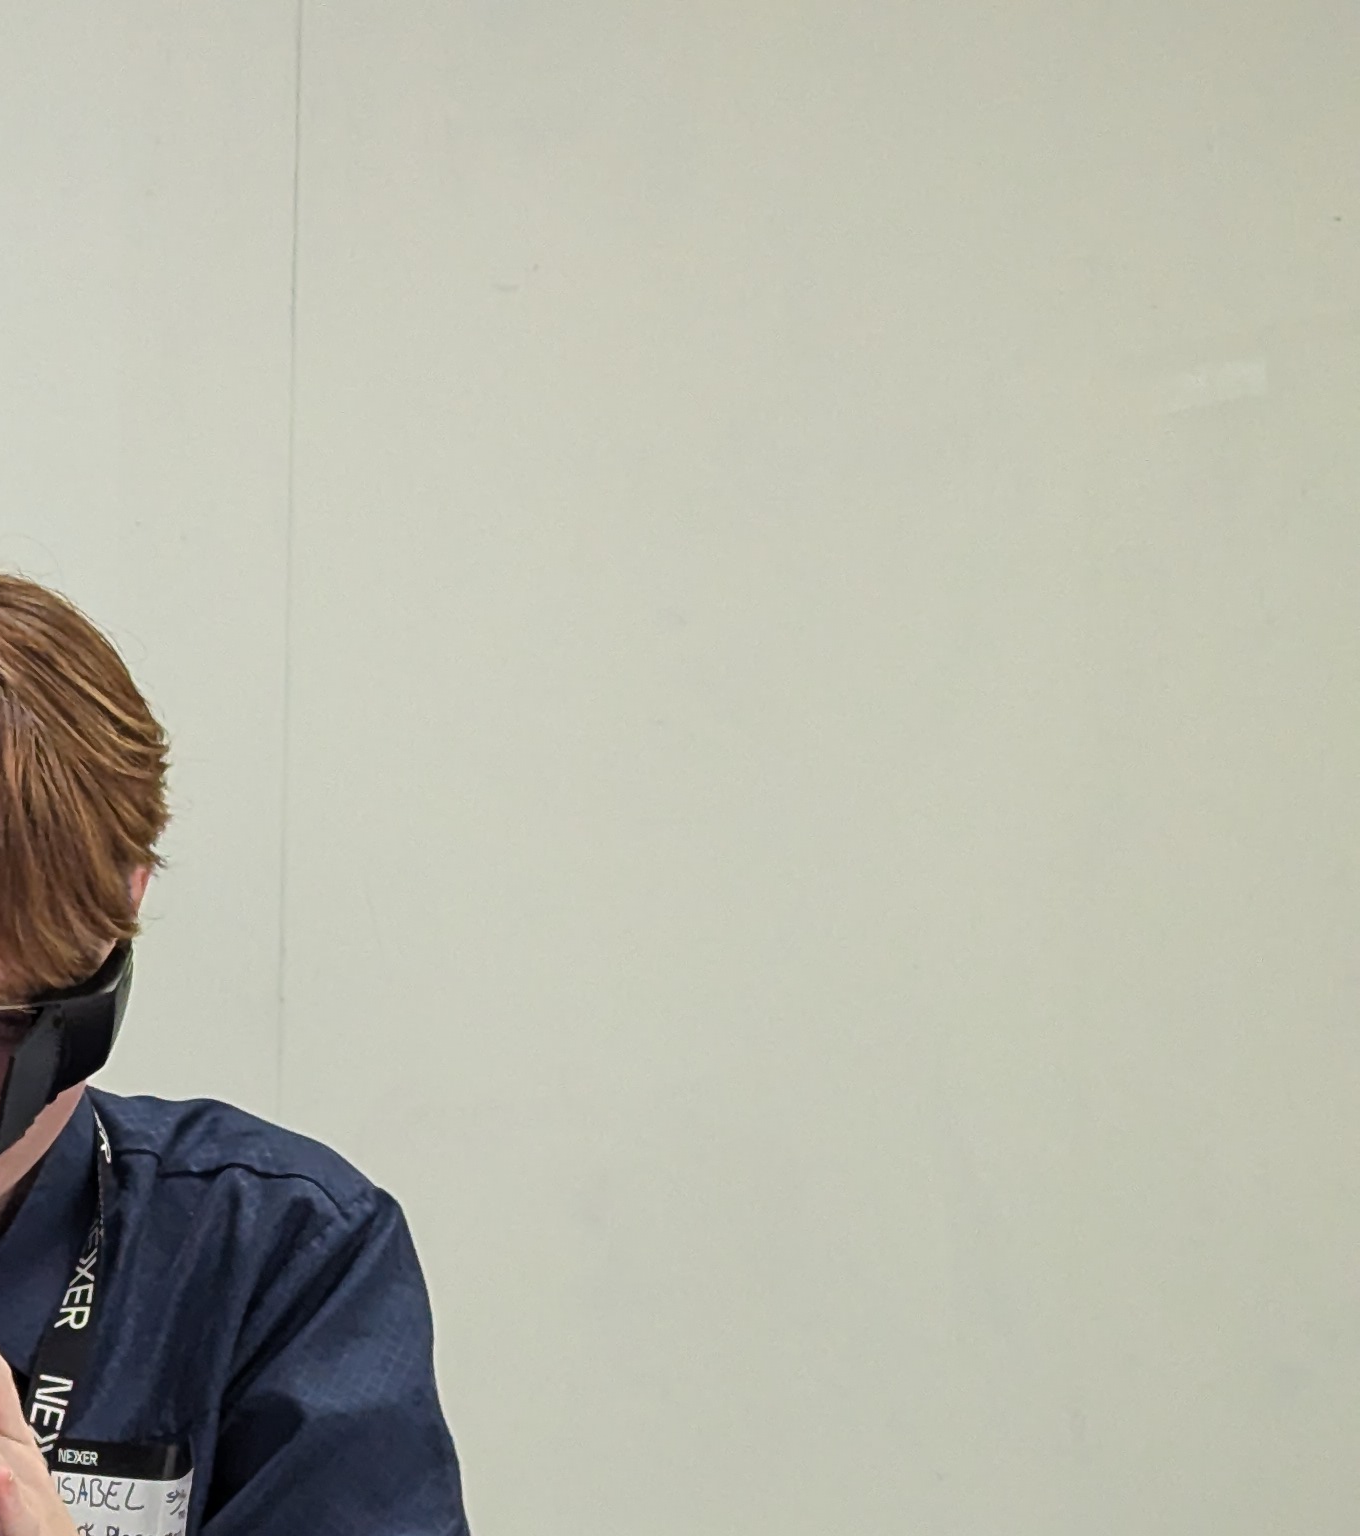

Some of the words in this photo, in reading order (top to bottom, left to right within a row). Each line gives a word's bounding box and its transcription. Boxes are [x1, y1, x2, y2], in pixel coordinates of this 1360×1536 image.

[54, 1221, 103, 1329] EXER
[57, 1448, 99, 1466] NEXER
[57, 1476, 145, 1512] ISABEL
